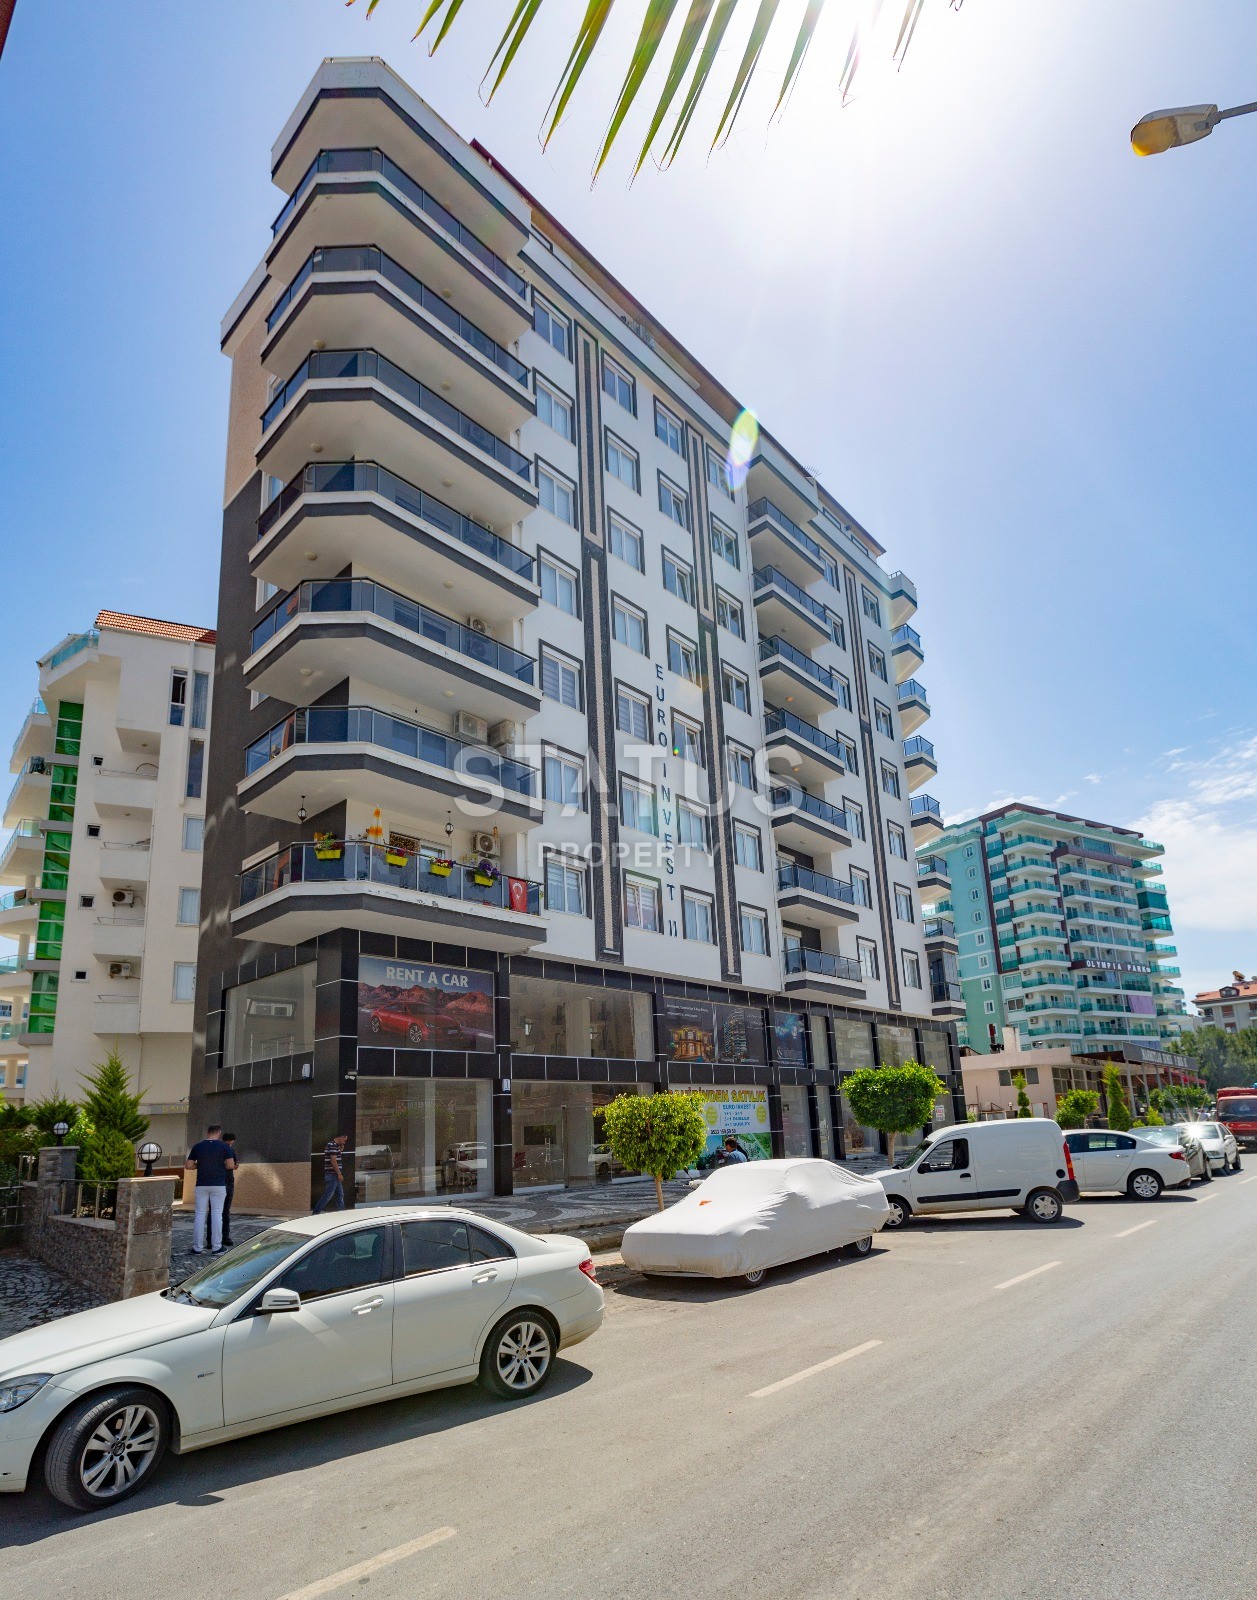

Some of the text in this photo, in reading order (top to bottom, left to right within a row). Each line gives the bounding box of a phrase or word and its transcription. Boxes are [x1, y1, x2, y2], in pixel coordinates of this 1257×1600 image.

[655, 663, 668, 748] EURO
[660, 761, 676, 901] INVEST
[386, 966, 469, 988] RENT A CAR
[1086, 960, 1122, 970] OLYMPIA
